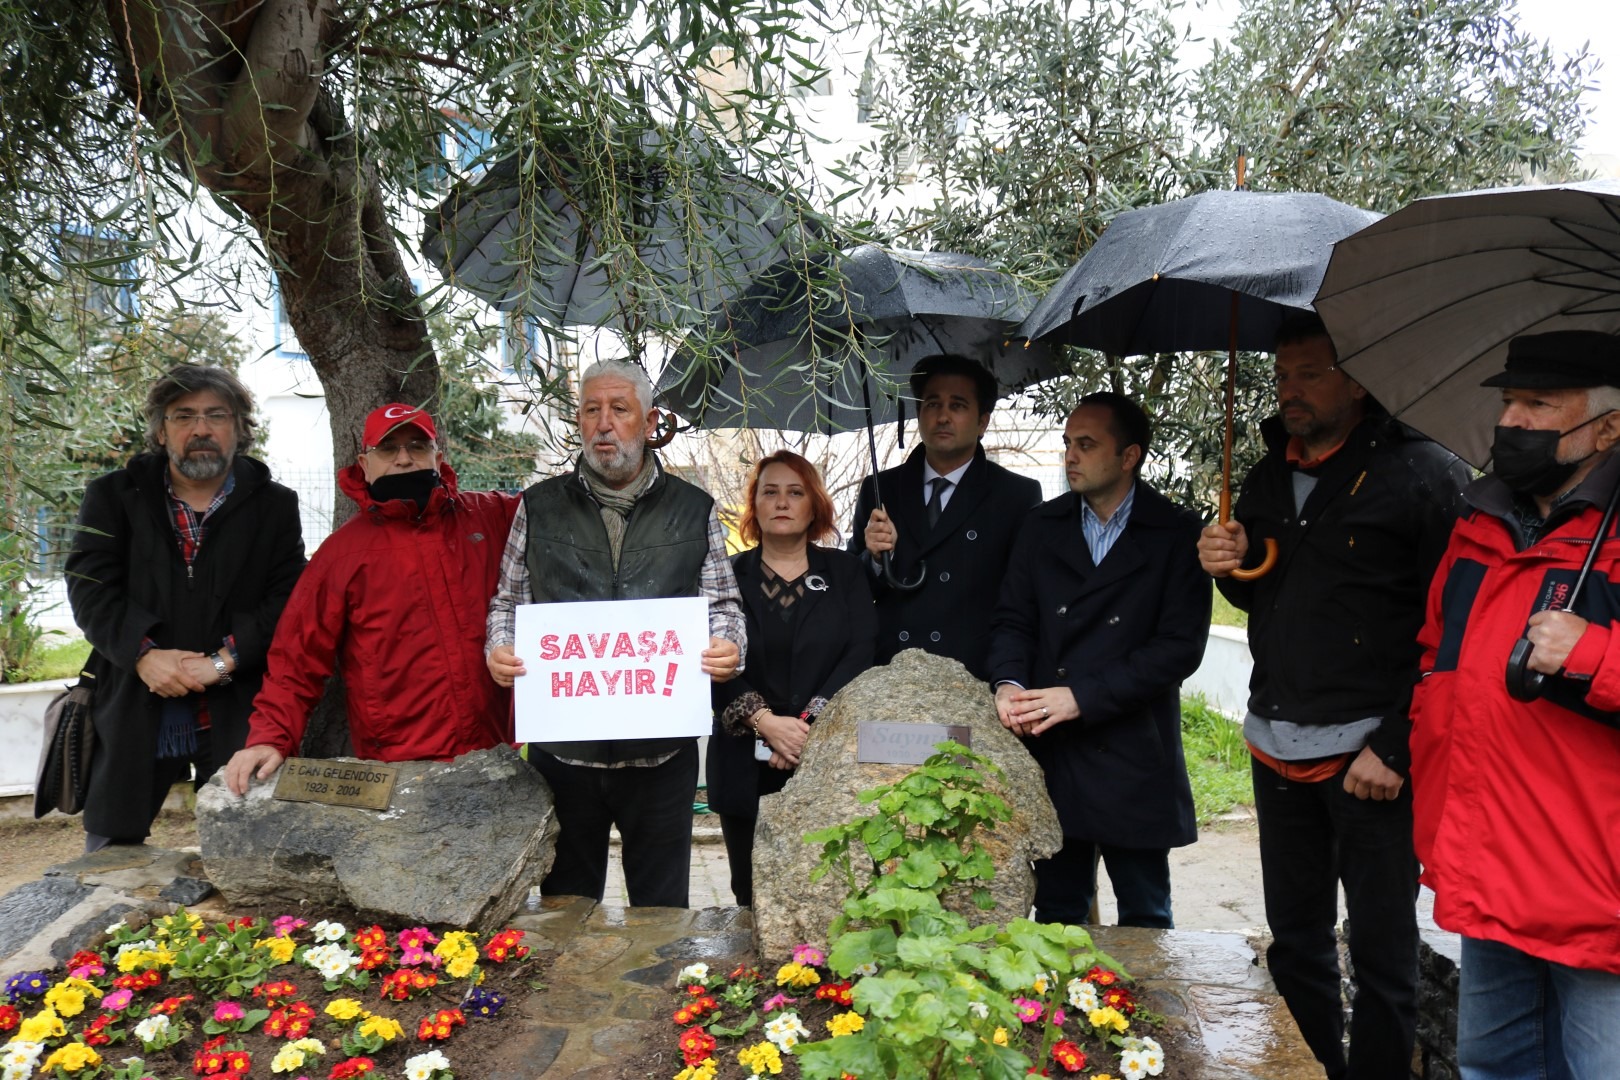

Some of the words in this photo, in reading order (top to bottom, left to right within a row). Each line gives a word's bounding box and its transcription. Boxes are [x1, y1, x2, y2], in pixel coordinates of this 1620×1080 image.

[539, 630, 684, 663] SAVAŞA
[298, 766, 320, 777] CAN
[323, 768, 389, 783] GELENDOST
[305, 782, 329, 794] 1928
[336, 785, 361, 797] 2004
